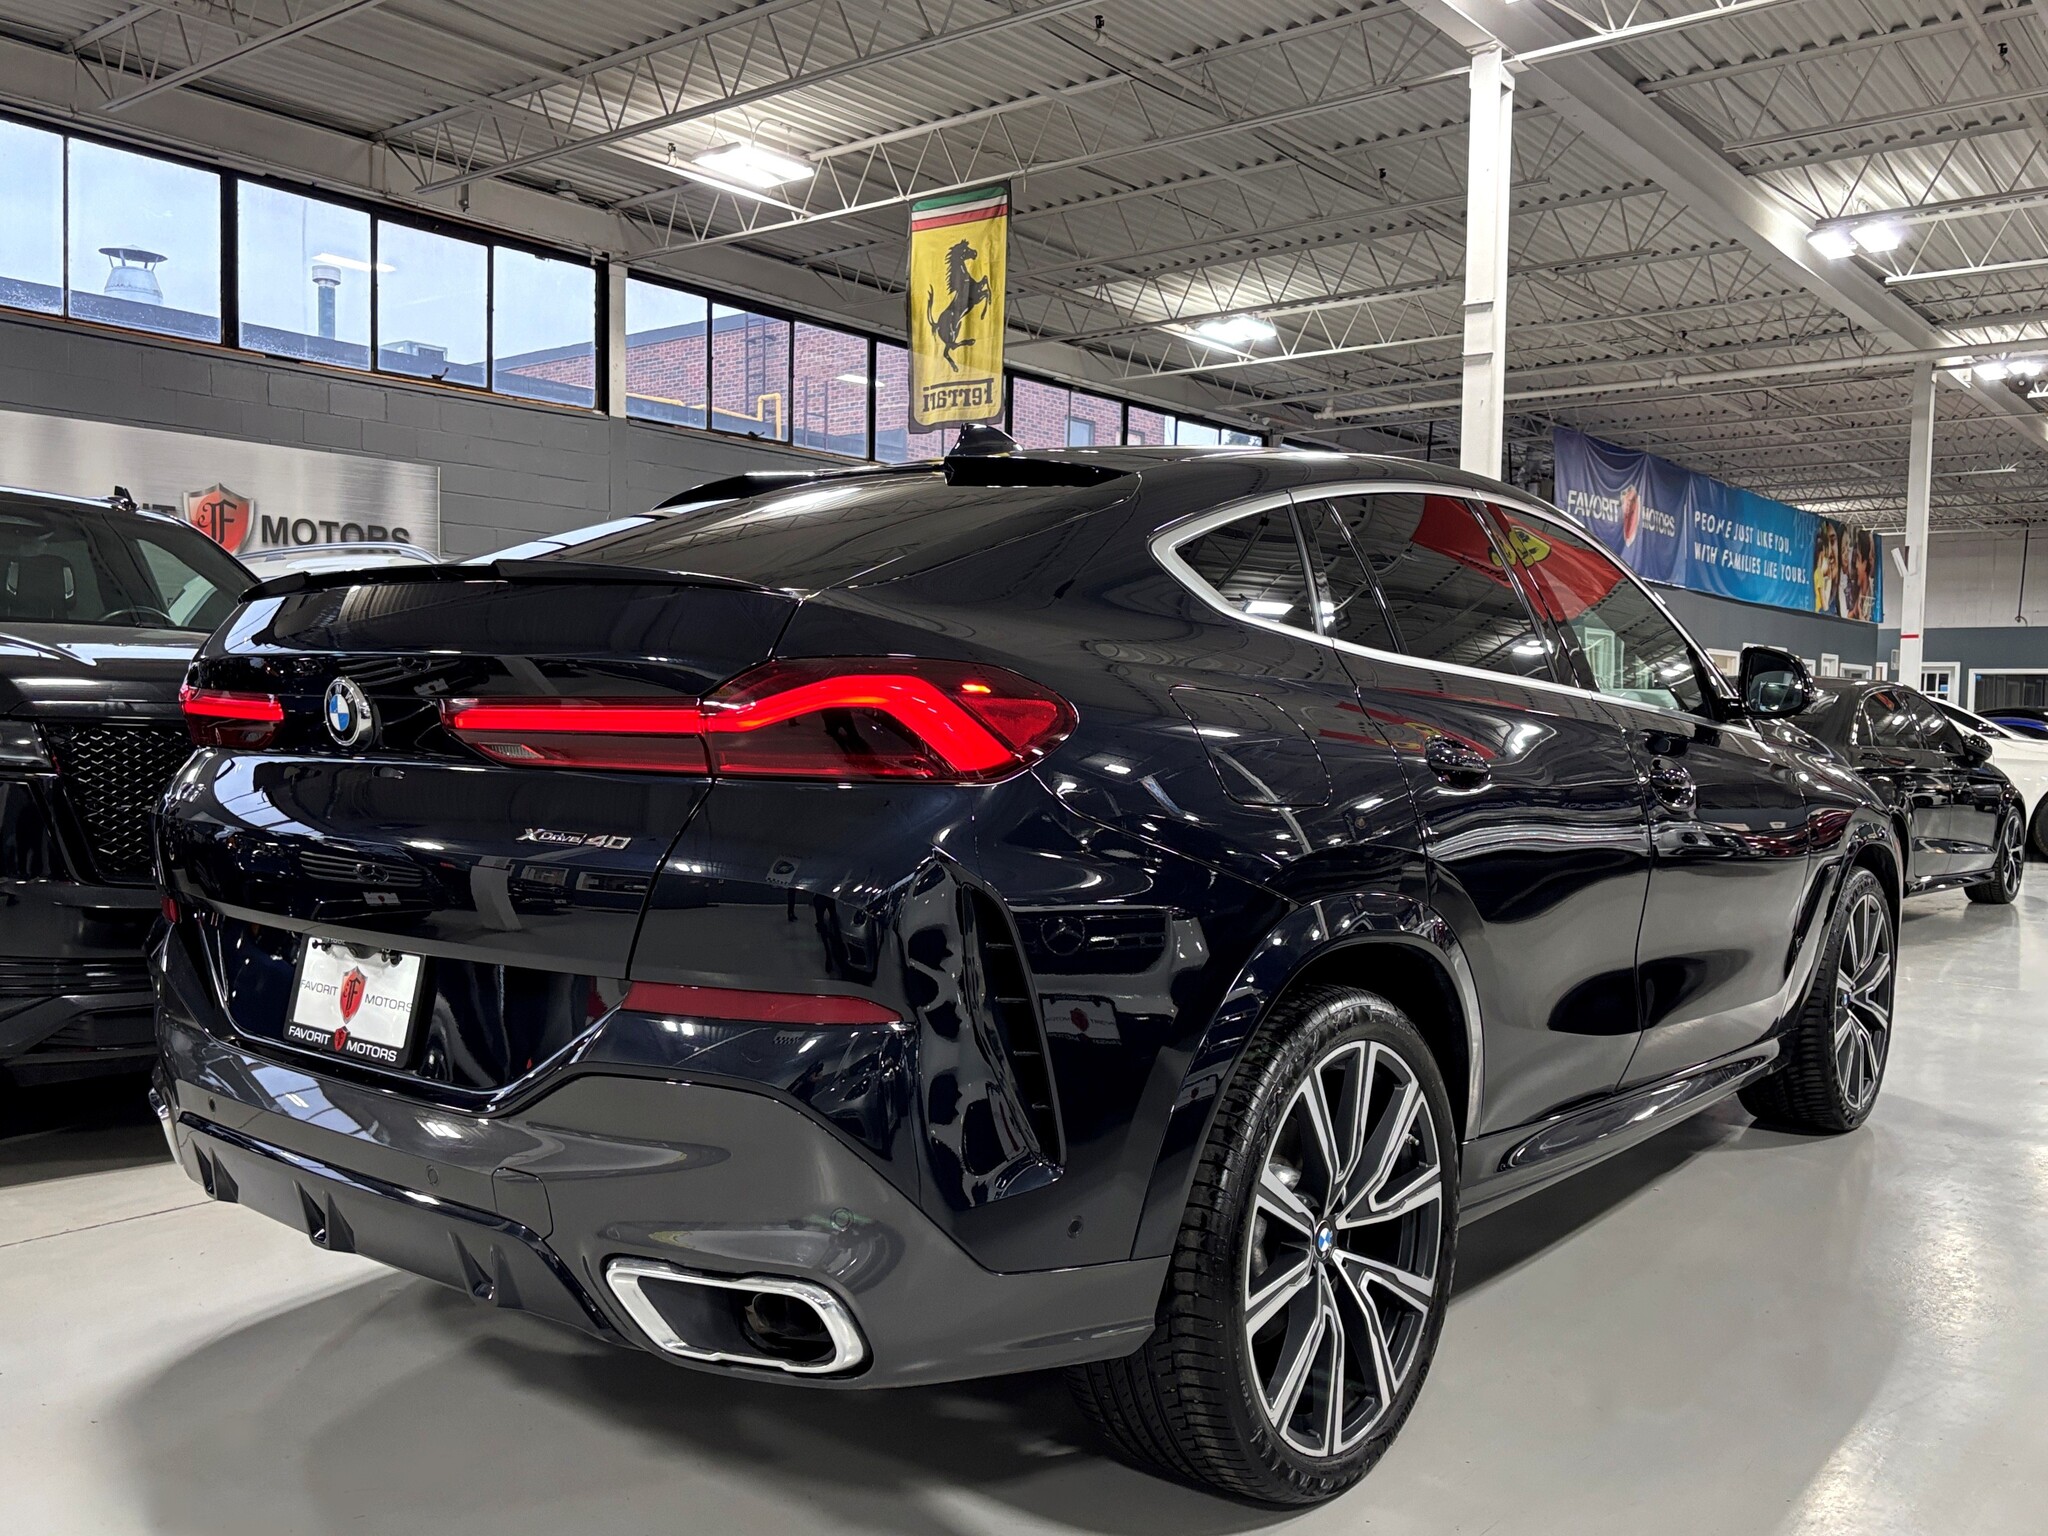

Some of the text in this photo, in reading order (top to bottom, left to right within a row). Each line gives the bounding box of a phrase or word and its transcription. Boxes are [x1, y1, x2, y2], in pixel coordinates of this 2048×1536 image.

[260, 514, 411, 547] MOTORS
[1567, 490, 1675, 537] FAVORIT MOTORS
[1733, 523, 1753, 544] JUST
[1757, 529, 1773, 549] LIKE
[1694, 541, 1809, 585] WITH FAMILIES LIKE YOURS.
[584, 834, 632, 850] 40
[300, 979, 339, 997] FAVORIT
[364, 993, 413, 1013] MOTORS
[288, 1025, 398, 1063] FAVORIT MOTORS
